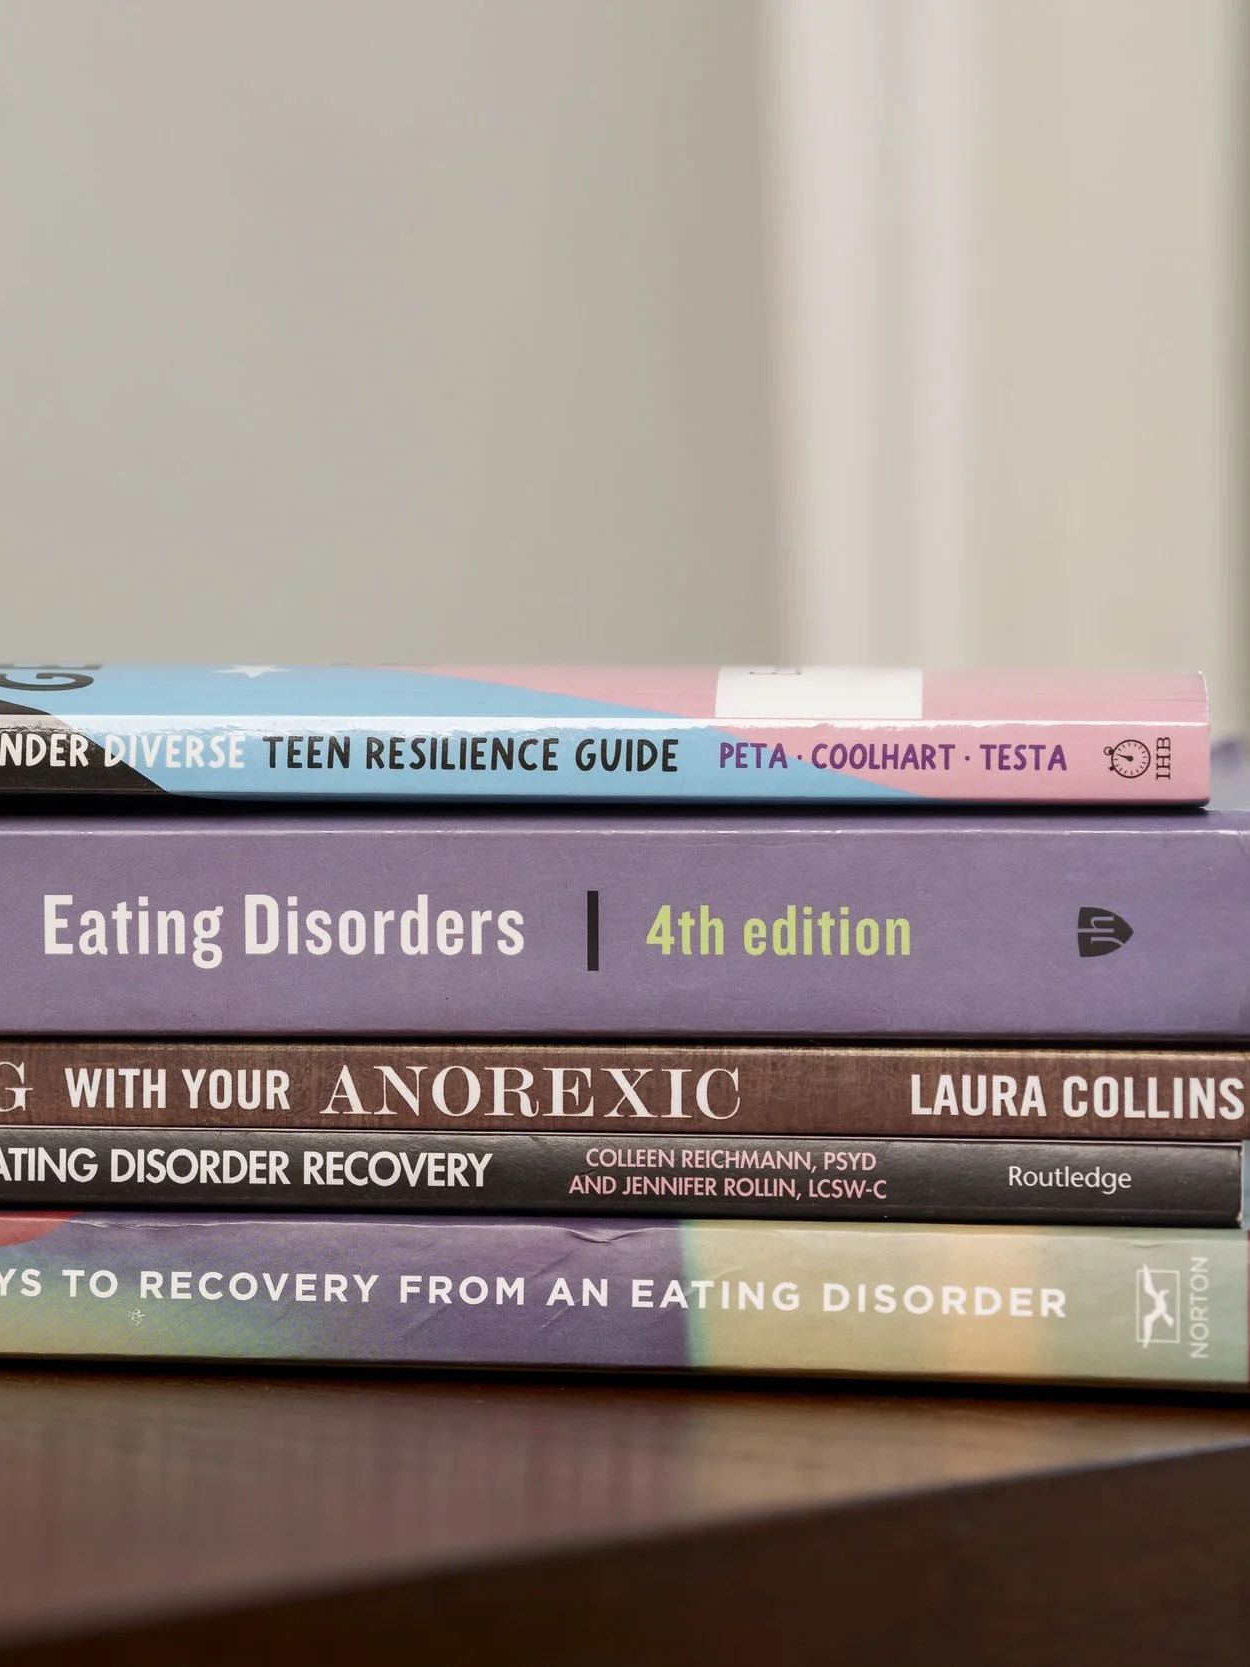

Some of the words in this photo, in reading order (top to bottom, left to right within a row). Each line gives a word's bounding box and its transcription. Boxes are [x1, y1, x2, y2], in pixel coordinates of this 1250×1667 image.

[104, 733, 246, 768] DIVERSE
[262, 735, 351, 769] TEEN
[366, 736, 559, 770] RESILIENCE
[575, 738, 679, 772] GUIDE
[719, 742, 788, 769] PETA
[811, 743, 956, 770] COOLHART
[979, 743, 1067, 771] TESTA
[1156, 737, 1171, 780] IHB
[43, 895, 223, 969] Eating
[245, 894, 526, 957] Disorders
[646, 905, 726, 956] 4th
[743, 905, 912, 956] edition
[65, 1068, 167, 1110] WITH
[182, 1069, 291, 1110] YOUR
[319, 1064, 741, 1119] ANOREXIC
[910, 1074, 1047, 1118] LAURA
[1062, 1076, 1245, 1121] COLLINS
[111, 1148, 291, 1185] DISORDER
[303, 1151, 494, 1188] RECOVERY
[585, 1147, 675, 1168] COLLEEN
[681, 1150, 817, 1173] REICHMANN,
[824, 1151, 877, 1171] PSYD
[1008, 1164, 1132, 1194] Routledge
[568, 1175, 617, 1195] AND
[622, 1176, 718, 1197] JENNIFER
[724, 1177, 802, 1200] ROLLIN,
[808, 1179, 888, 1200] LCSW-C
[62, 1268, 118, 1299] TO
[139, 1271, 380, 1304] RECOVERY
[399, 1274, 526, 1307] FROM
[545, 1277, 612, 1307] AN
[632, 1278, 801, 1312] EATING
[822, 1282, 1067, 1317] DISORDER
[1190, 1257, 1209, 1359] NORTON
